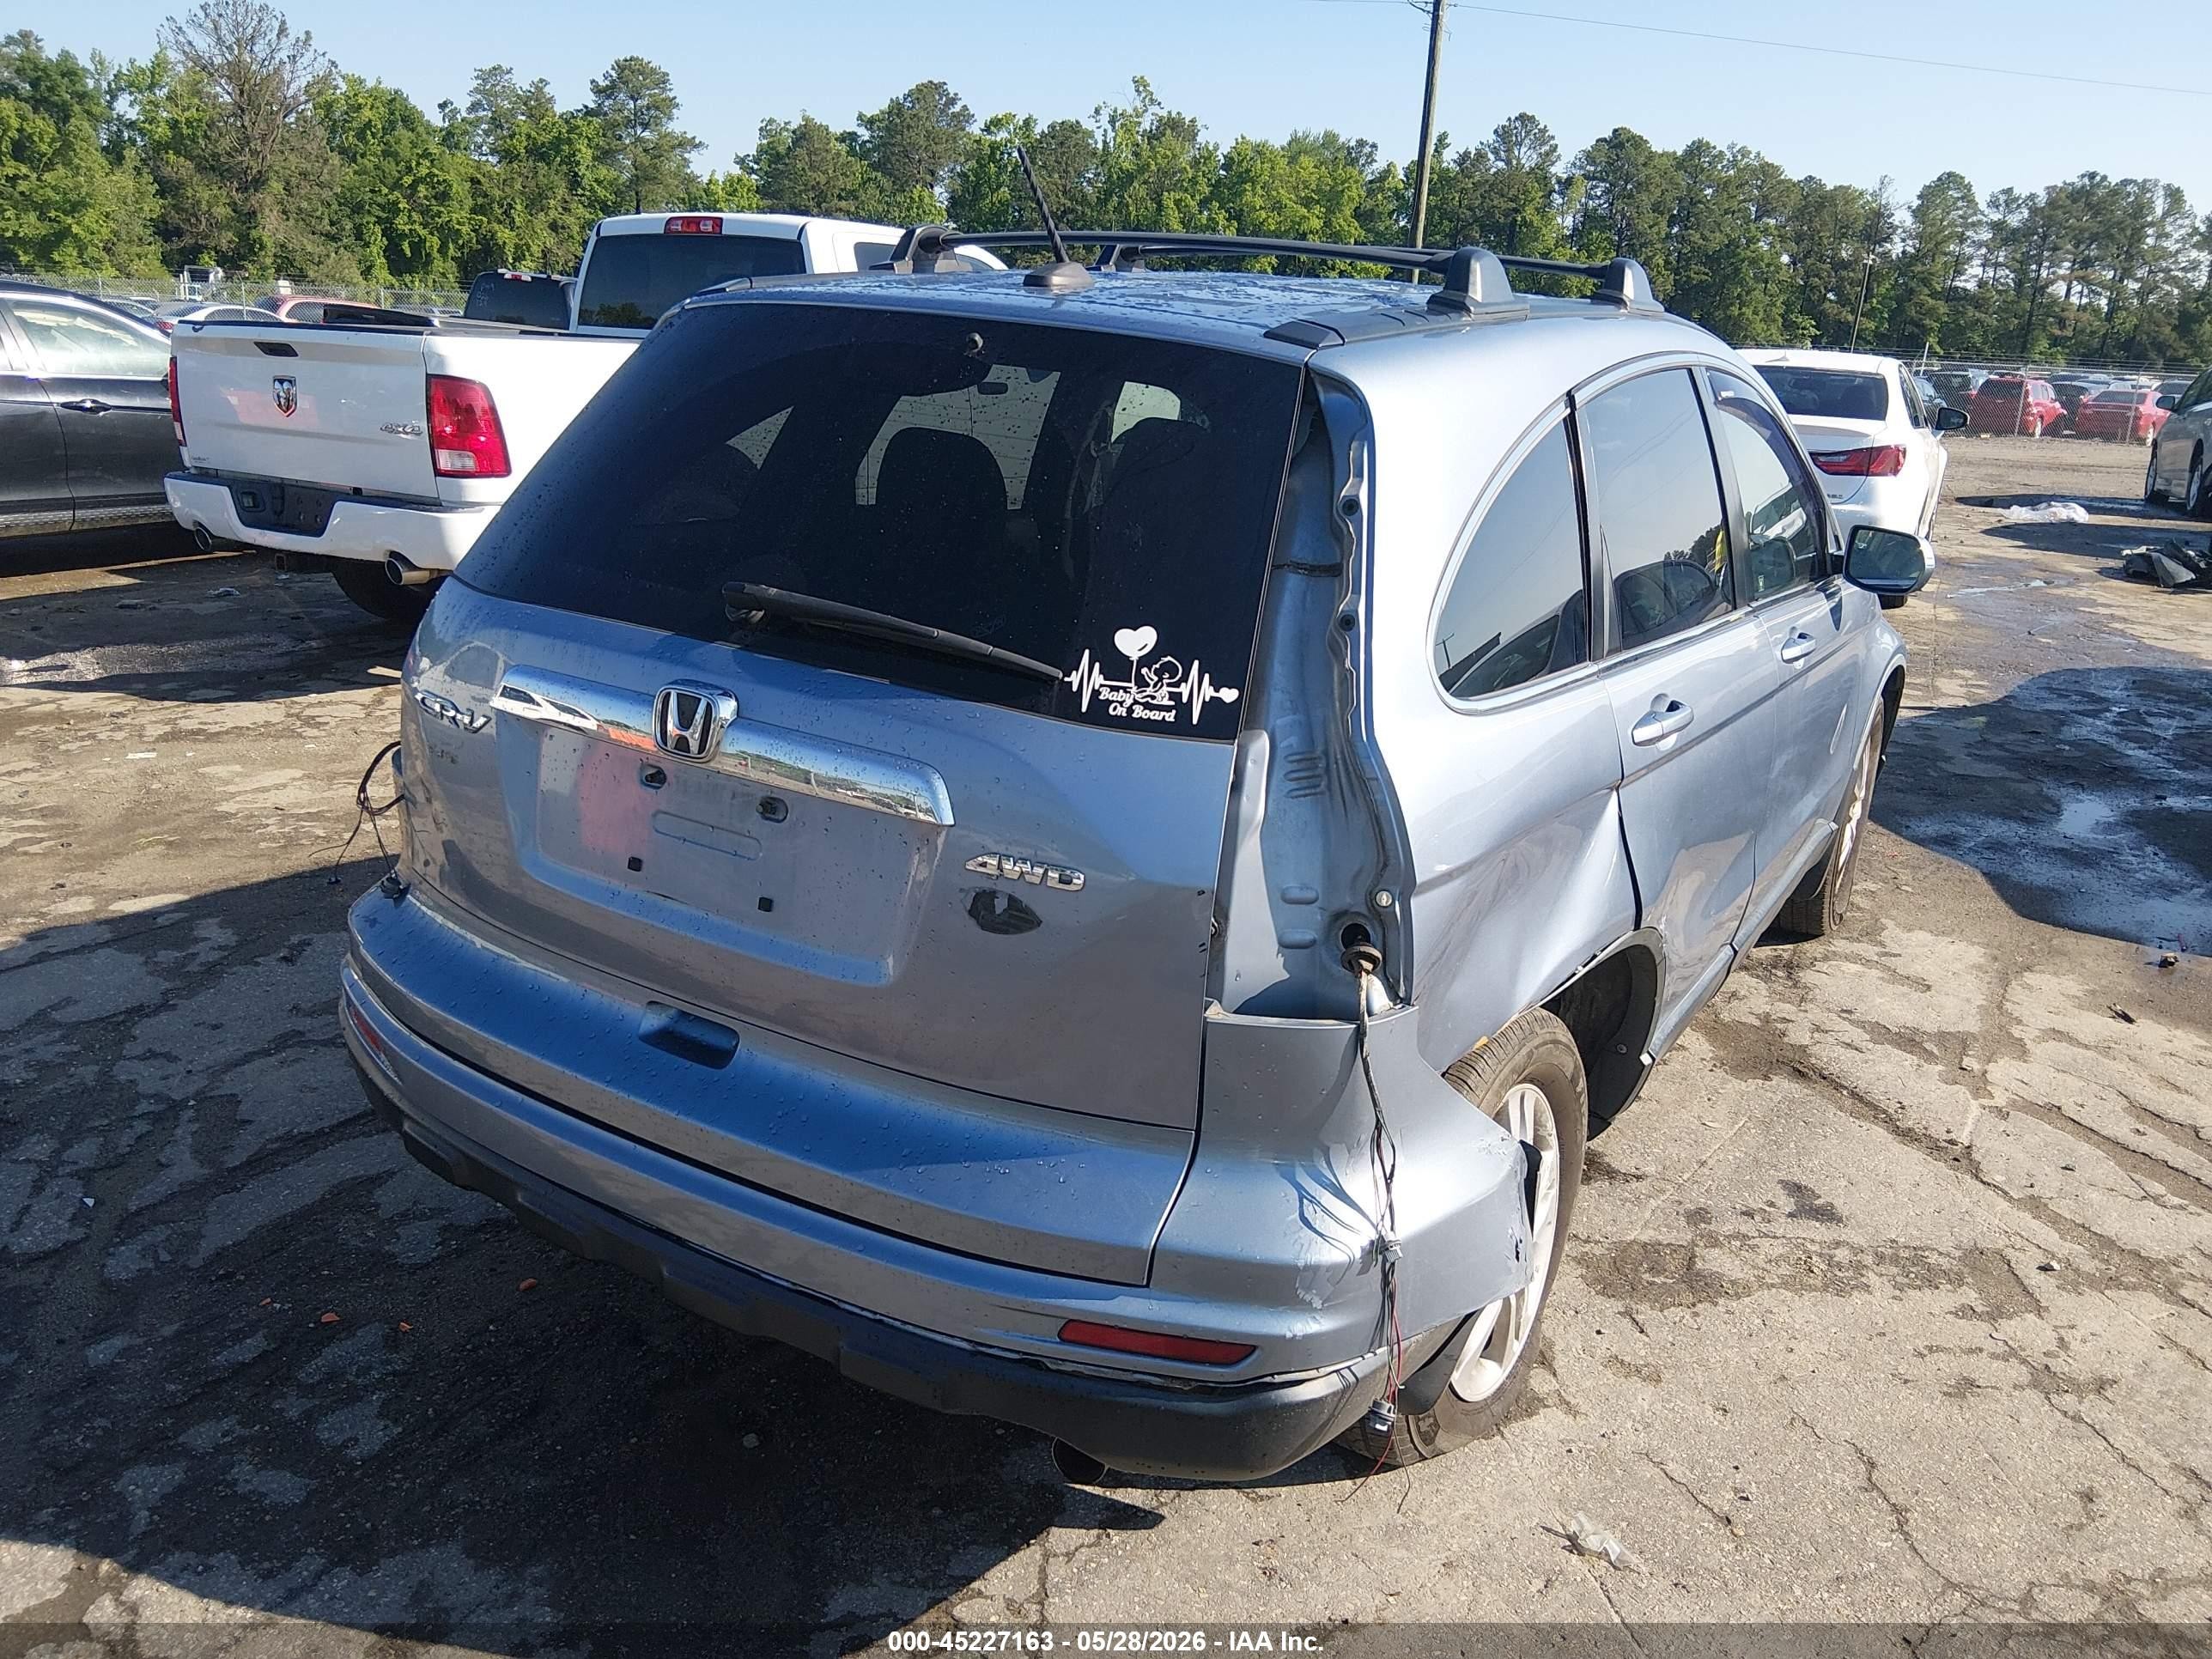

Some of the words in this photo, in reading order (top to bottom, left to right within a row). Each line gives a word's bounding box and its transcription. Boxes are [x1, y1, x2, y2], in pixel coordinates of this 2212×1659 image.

[1098, 687, 1133, 708] Baby
[1109, 702, 1127, 716] On
[1132, 705, 1176, 721] Board
[965, 853, 1085, 891] 4WD
